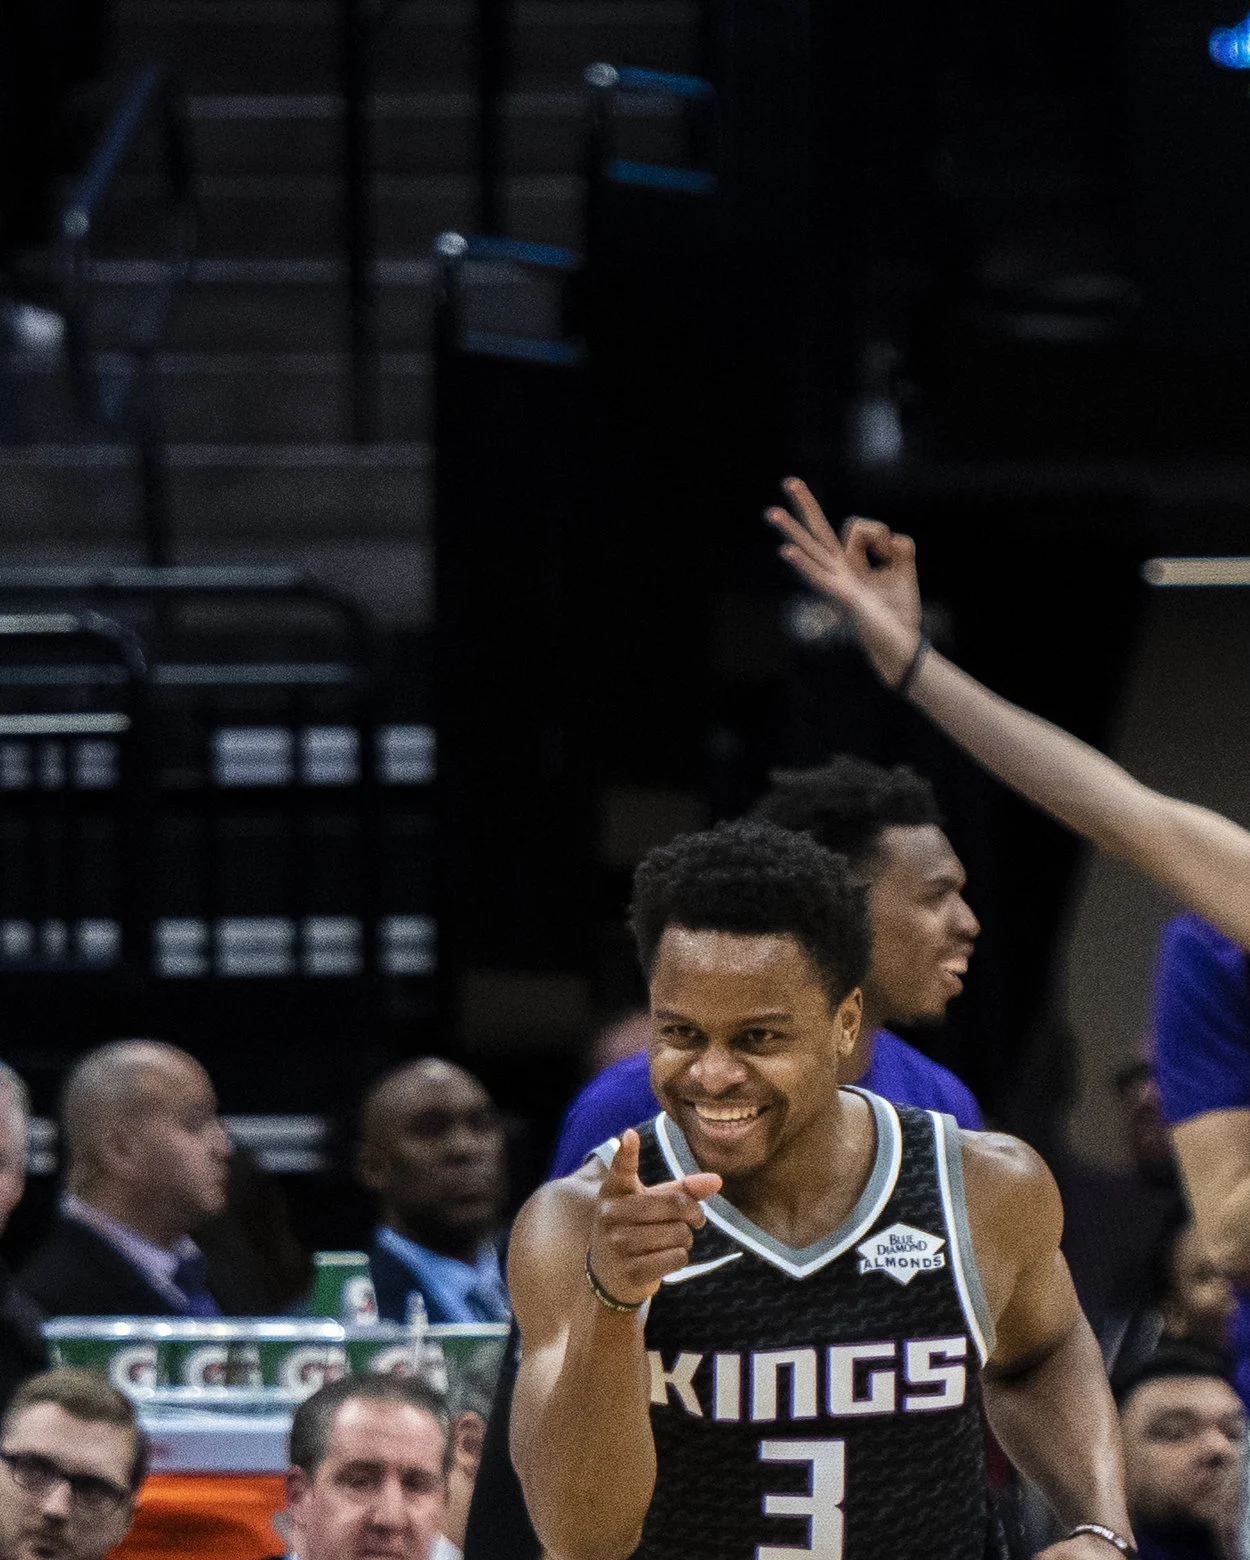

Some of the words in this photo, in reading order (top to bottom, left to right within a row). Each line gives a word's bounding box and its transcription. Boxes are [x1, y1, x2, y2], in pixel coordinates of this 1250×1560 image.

[877, 1240, 928, 1256] DIAMOND
[889, 1234, 914, 1246] BLUE
[864, 1254, 942, 1270] ALMONDS
[649, 1336, 967, 1422] KINGS
